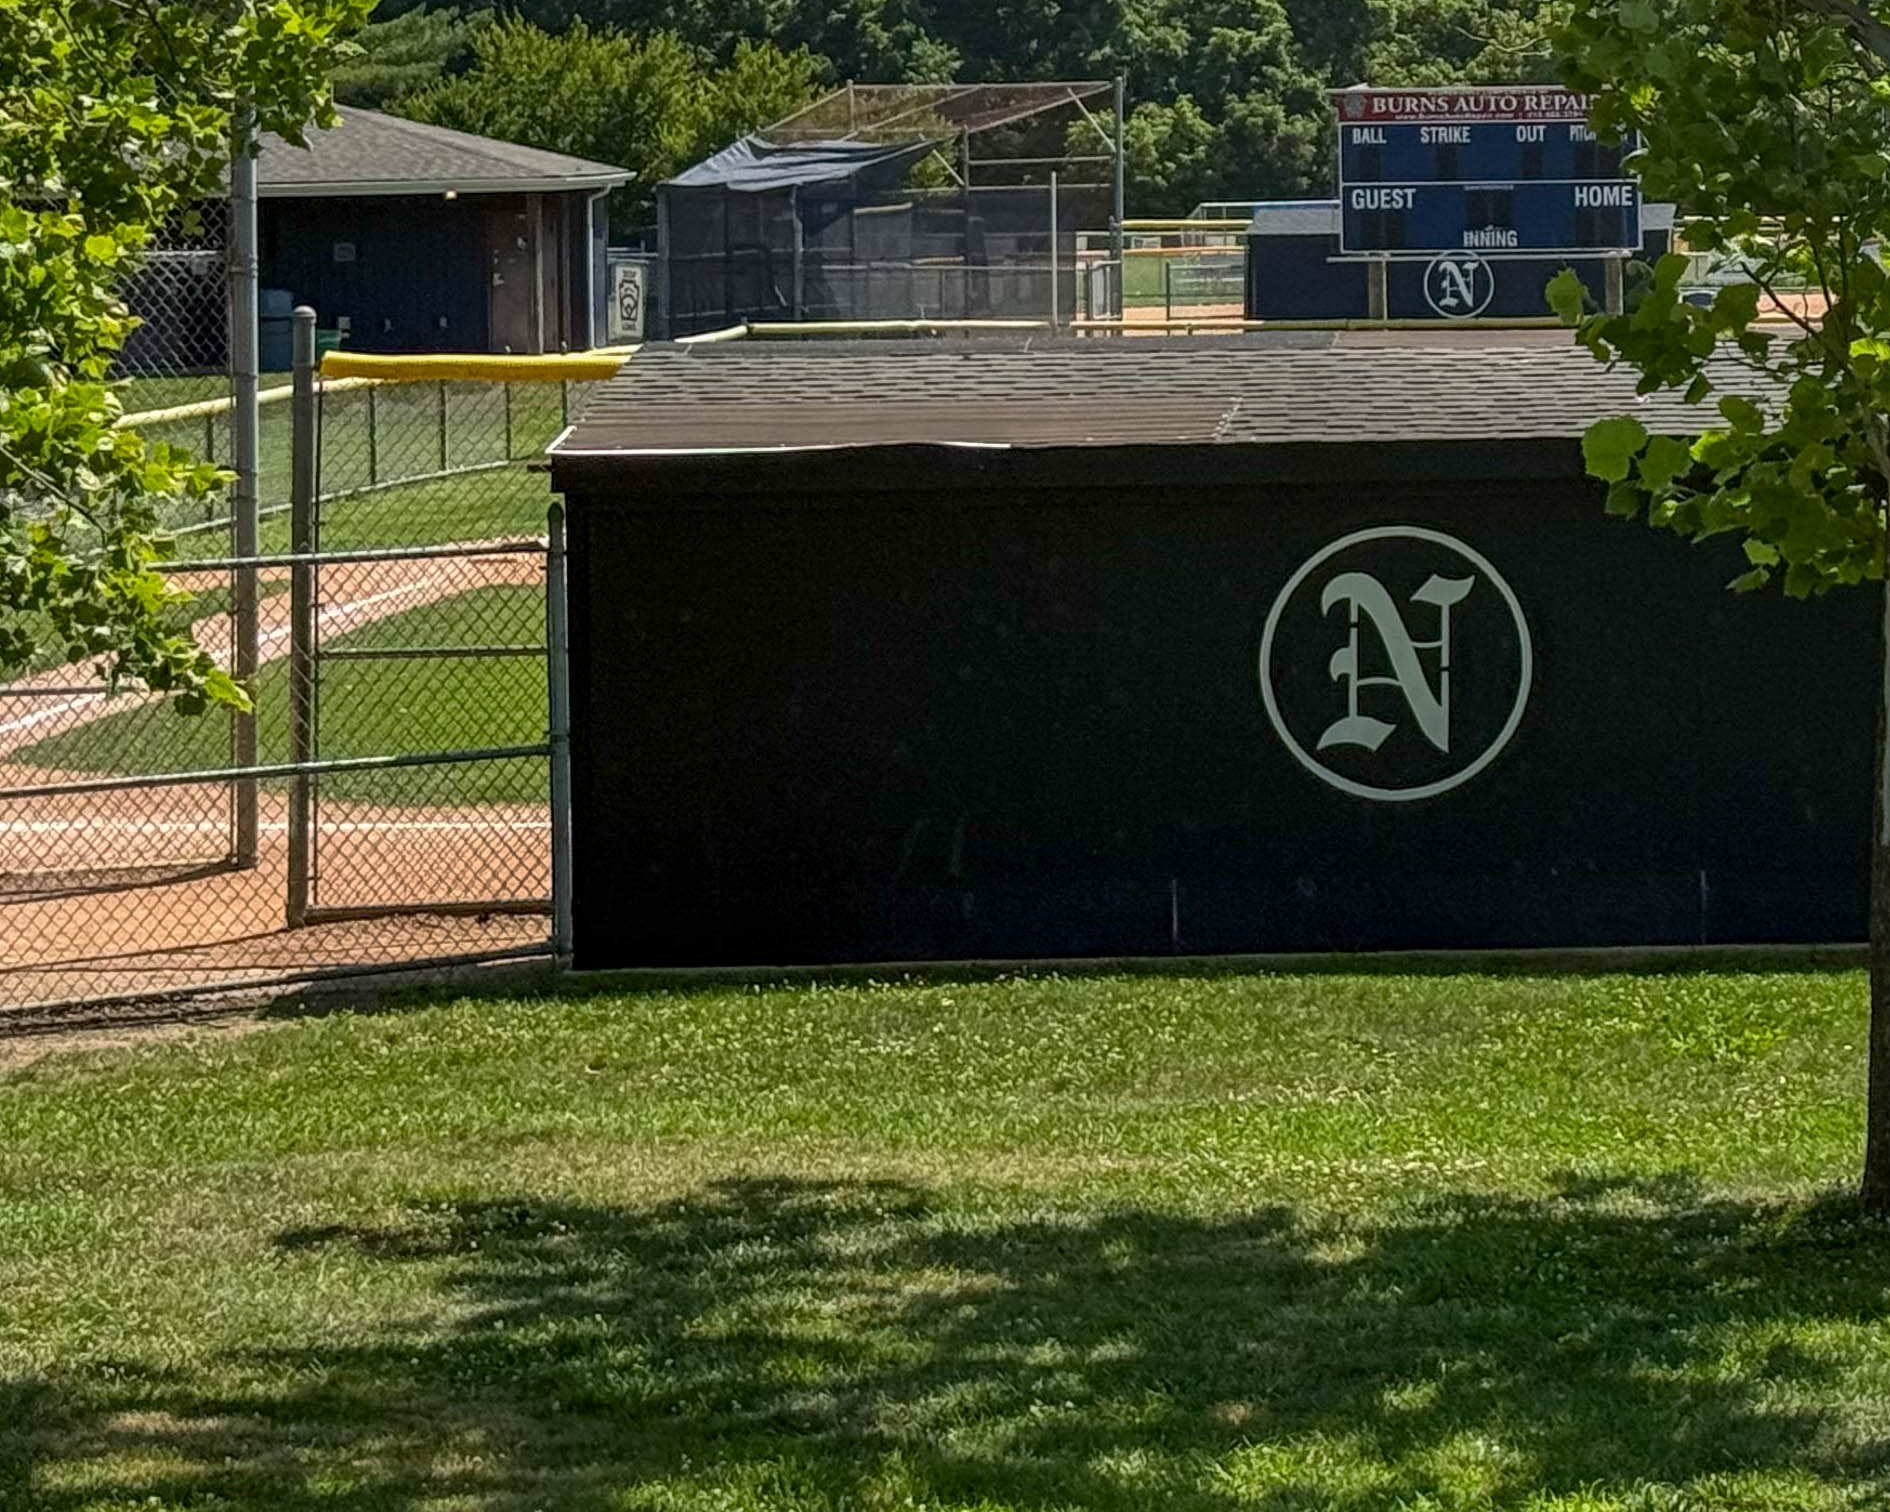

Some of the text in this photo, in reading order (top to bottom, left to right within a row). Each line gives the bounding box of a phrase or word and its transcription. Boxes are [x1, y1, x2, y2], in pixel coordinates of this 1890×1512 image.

[1372, 96, 1449, 114] BURNS
[1454, 94, 1518, 112] AUTO
[1352, 127, 1387, 145] BALL
[1420, 125, 1471, 144] STRIKE
[1516, 124, 1546, 143] OUT
[1352, 188, 1416, 210] GUEST
[1574, 185, 1633, 208] HOME
[1463, 229, 1518, 248] INNING
[1438, 260, 1480, 308] N
[1316, 571, 1475, 754] N
